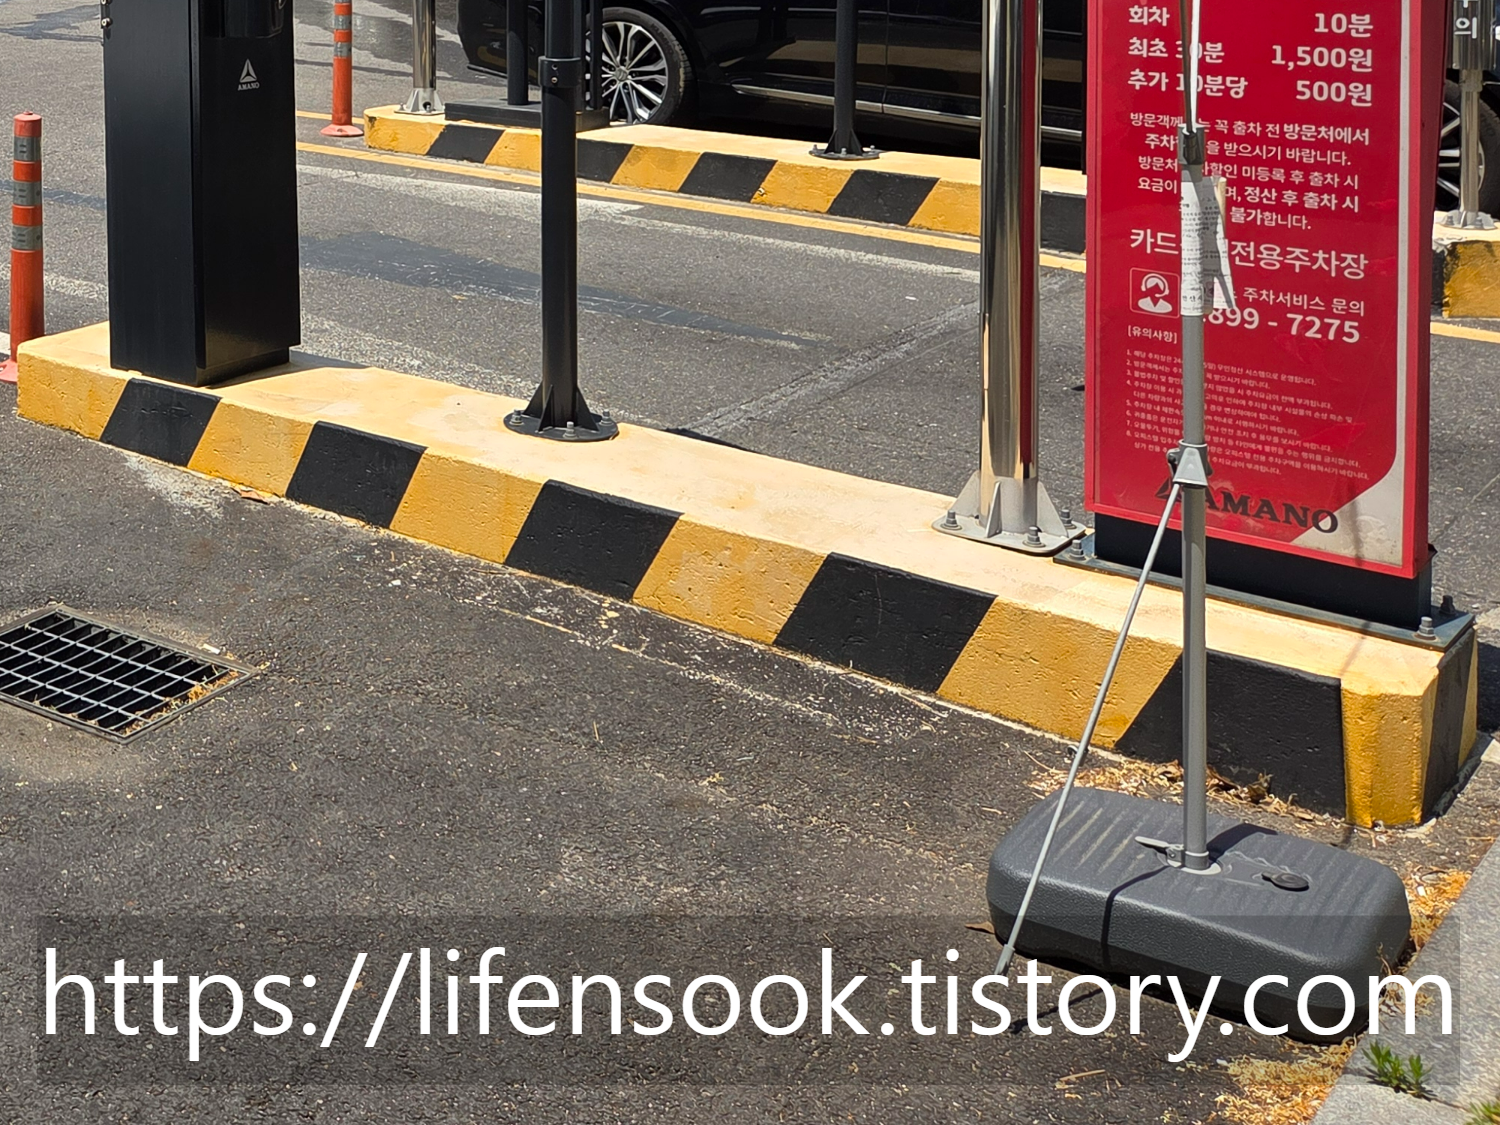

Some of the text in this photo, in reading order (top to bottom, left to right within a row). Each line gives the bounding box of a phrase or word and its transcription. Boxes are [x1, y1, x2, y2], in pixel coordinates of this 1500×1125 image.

[1128, 6, 1374, 38] 회차 10분
[1128, 37, 1169, 59] 최초
[1271, 45, 1373, 73] 1,500원
[1127, 68, 1169, 92] 추가
[1296, 80, 1373, 107] 500원
[1214, 119, 1229, 134] 꼭
[1233, 120, 1262, 138] 출차
[1265, 123, 1280, 139] 전
[1283, 124, 1370, 146] 방문처에서
[1224, 141, 1282, 161] 받으시기
[1285, 146, 1351, 166] 바랍니다.
[1242, 165, 1286, 183] 미등록
[1289, 169, 1305, 185] 후
[1308, 171, 1340, 188] 출차
[1343, 174, 1359, 190] 시
[1138, 176, 1178, 194] 요금이
[1243, 186, 1278, 206] 정산
[1281, 189, 1299, 207] 후
[1303, 191, 1338, 211] 출차
[1342, 195, 1359, 213] 시
[1230, 207, 1312, 230] 불가합니다.
[1242, 287, 1365, 316] 주차서비스 문의
[1127, 324, 1178, 344] [유의사항]
